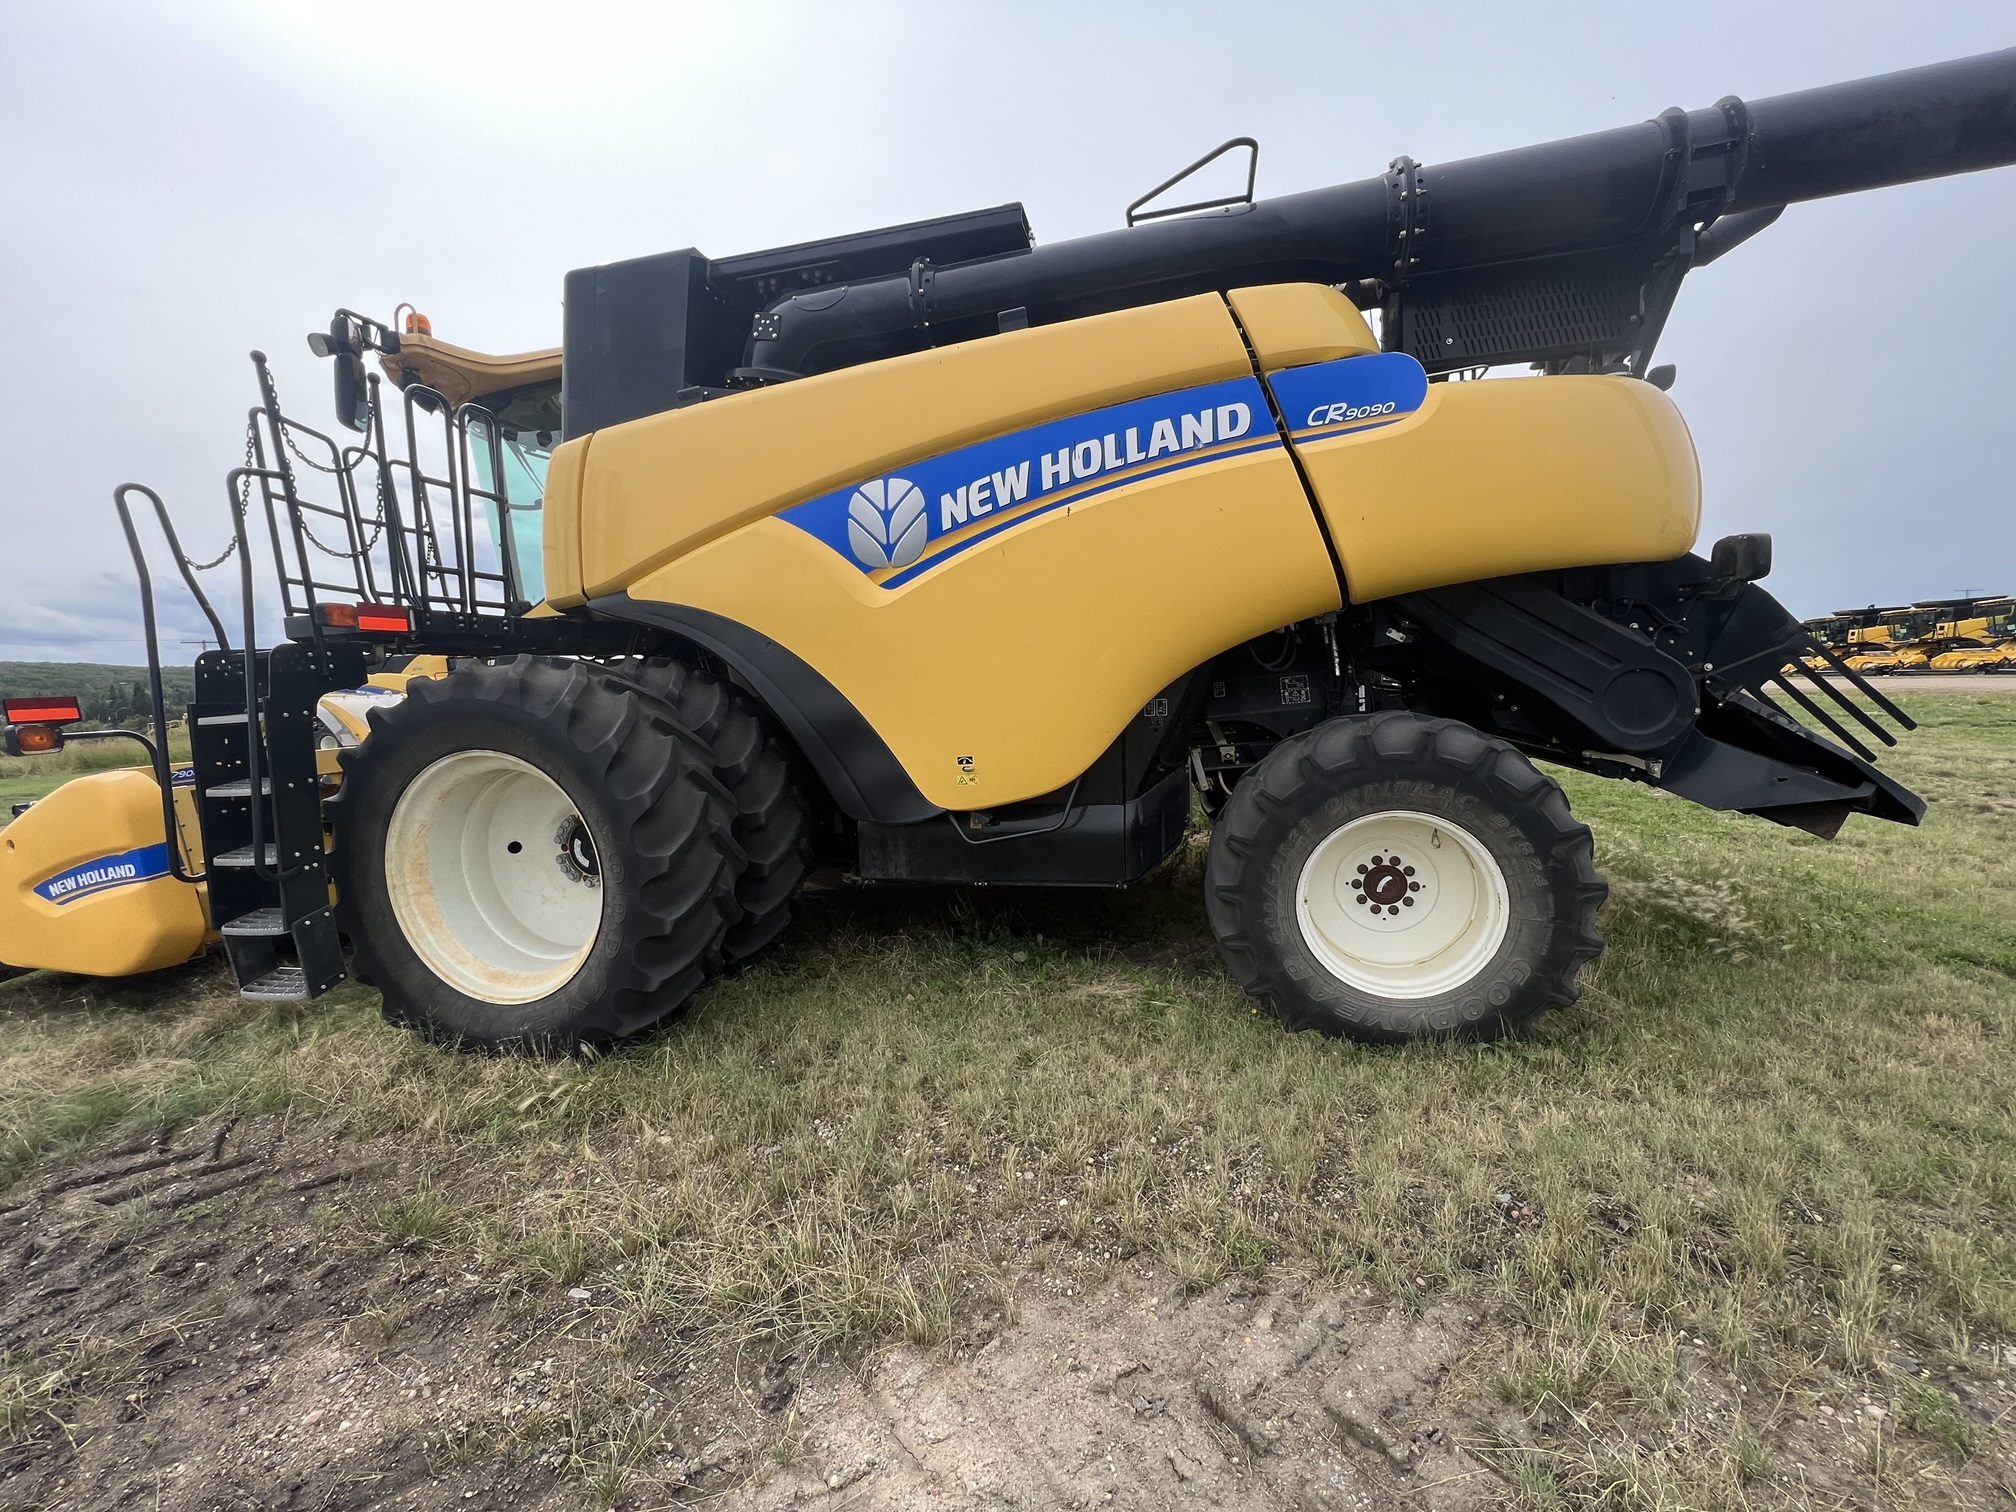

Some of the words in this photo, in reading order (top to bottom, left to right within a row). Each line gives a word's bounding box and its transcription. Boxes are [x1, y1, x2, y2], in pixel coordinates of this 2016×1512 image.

[1307, 402, 1396, 427] CR9090
[940, 460, 1030, 532] NEW
[1039, 402, 1252, 491] HOLLAND
[1324, 781, 1479, 812] OPTITRAC
[1490, 813, 1549, 887] DT824
[48, 876, 76, 897] NEW
[77, 864, 136, 887] HOLLAND
[1283, 957, 1532, 1032] GOODYEAR
